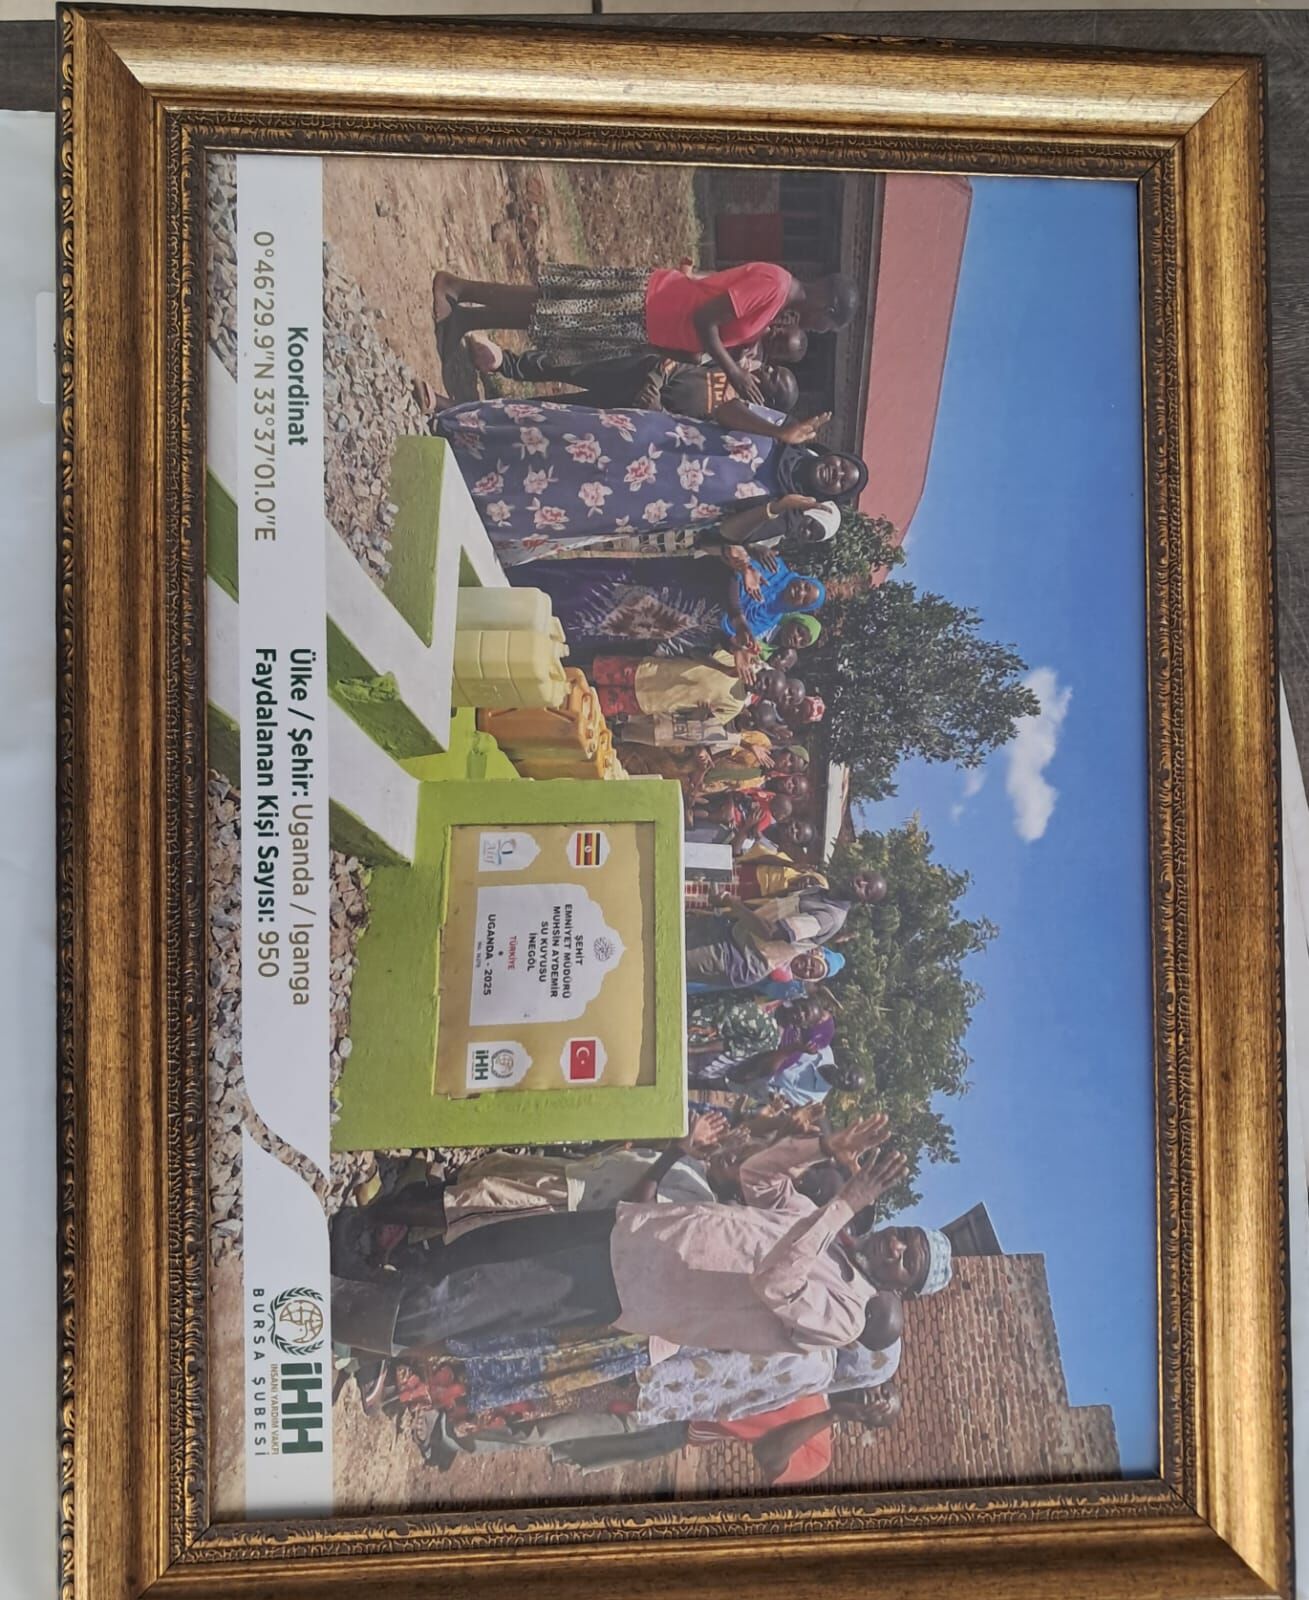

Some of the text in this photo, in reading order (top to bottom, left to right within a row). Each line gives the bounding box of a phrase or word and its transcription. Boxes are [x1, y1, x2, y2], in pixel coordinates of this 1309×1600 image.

[287, 327, 309, 445] Koordinat
[252, 648, 279, 977] Faydalanan Kişi Sayısı: 950
[288, 648, 316, 1005] Ülke / Şehir: Uganda / Iganga
[484, 969, 492, 995] 2025
[485, 914, 496, 959] UGANDA
[527, 933, 537, 971] İNEGÖL
[539, 921, 548, 982] SU KUYUSU
[550, 906, 561, 997] MUHSİN AYDEMİR
[562, 904, 572, 999] EMNİYET MÜDÜRÜ
[574, 935, 583, 965] ŞEHİT
[251, 1288, 269, 1455] BURSA ŞUBESİ
